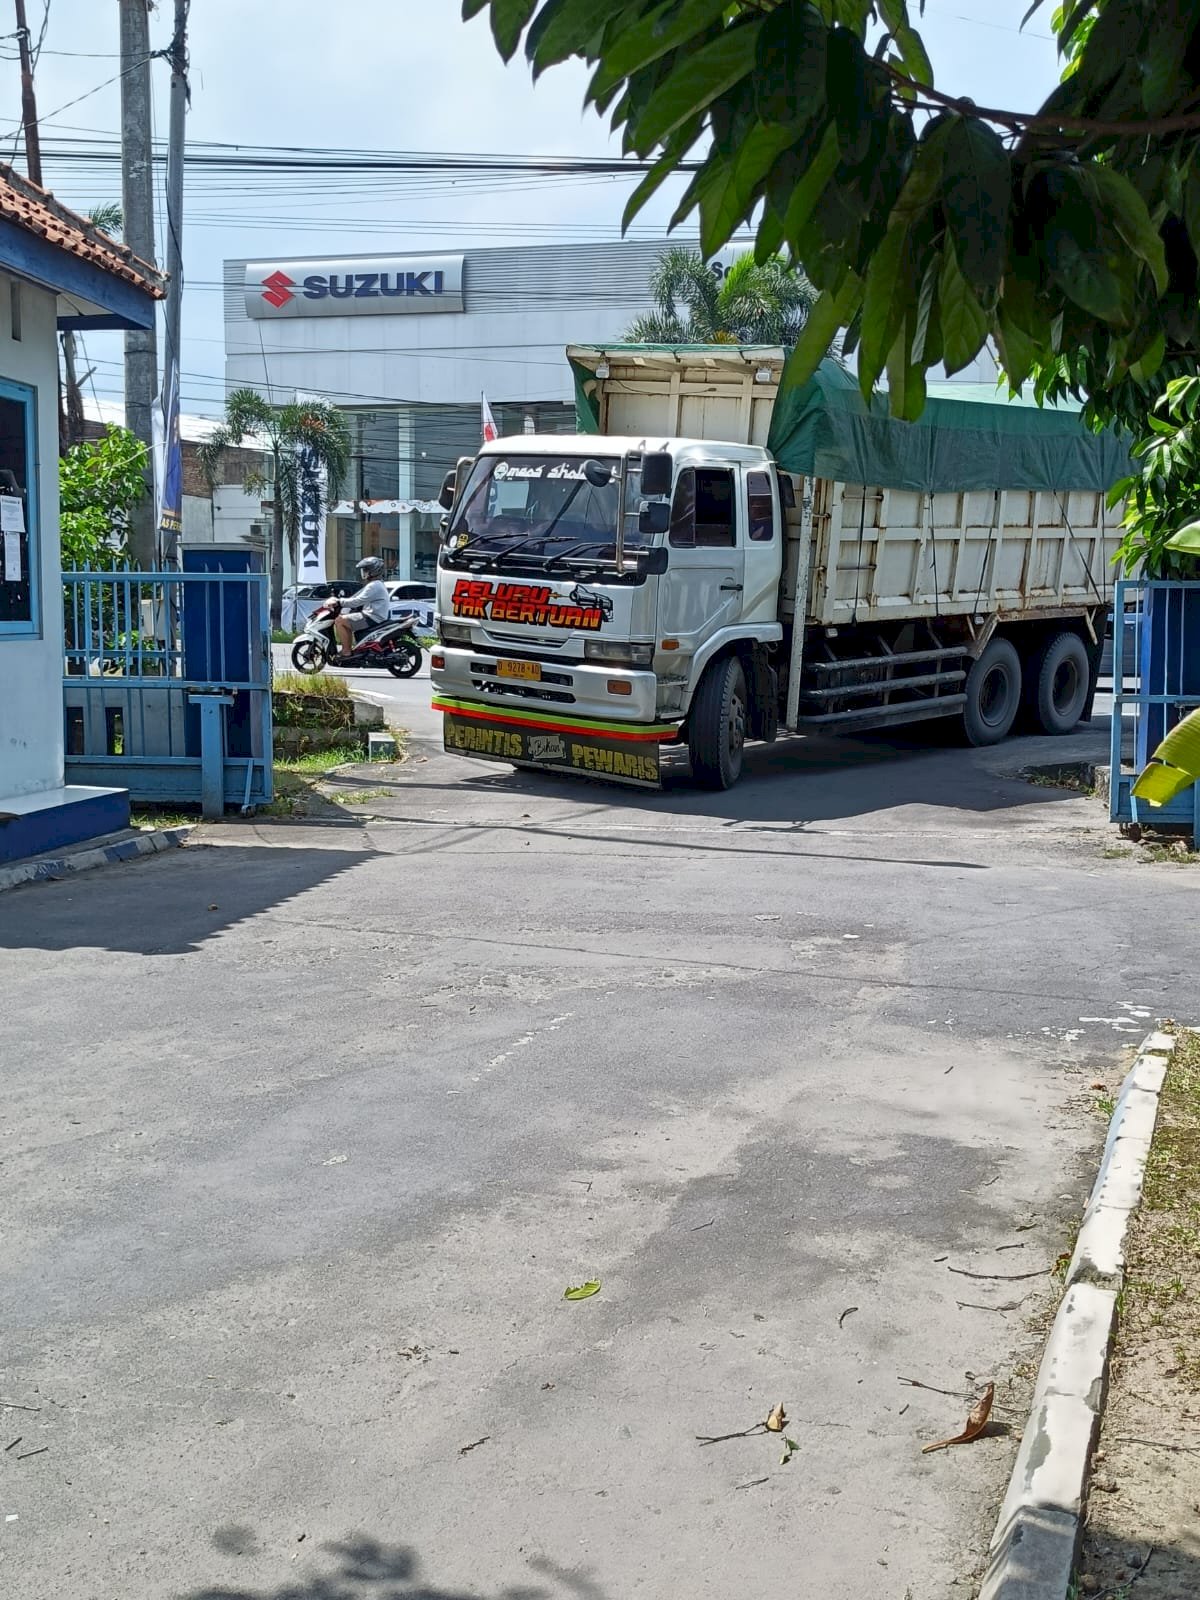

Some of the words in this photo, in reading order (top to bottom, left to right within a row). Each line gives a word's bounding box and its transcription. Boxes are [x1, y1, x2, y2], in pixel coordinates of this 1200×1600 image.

[302, 270, 444, 299] SUZUKI
[454, 579, 552, 604] PELURU
[452, 596, 487, 618] TAK
[491, 601, 602, 630] BERTUAN
[444, 723, 522, 757] PERINTIS
[571, 743, 659, 780] PEWARIS
